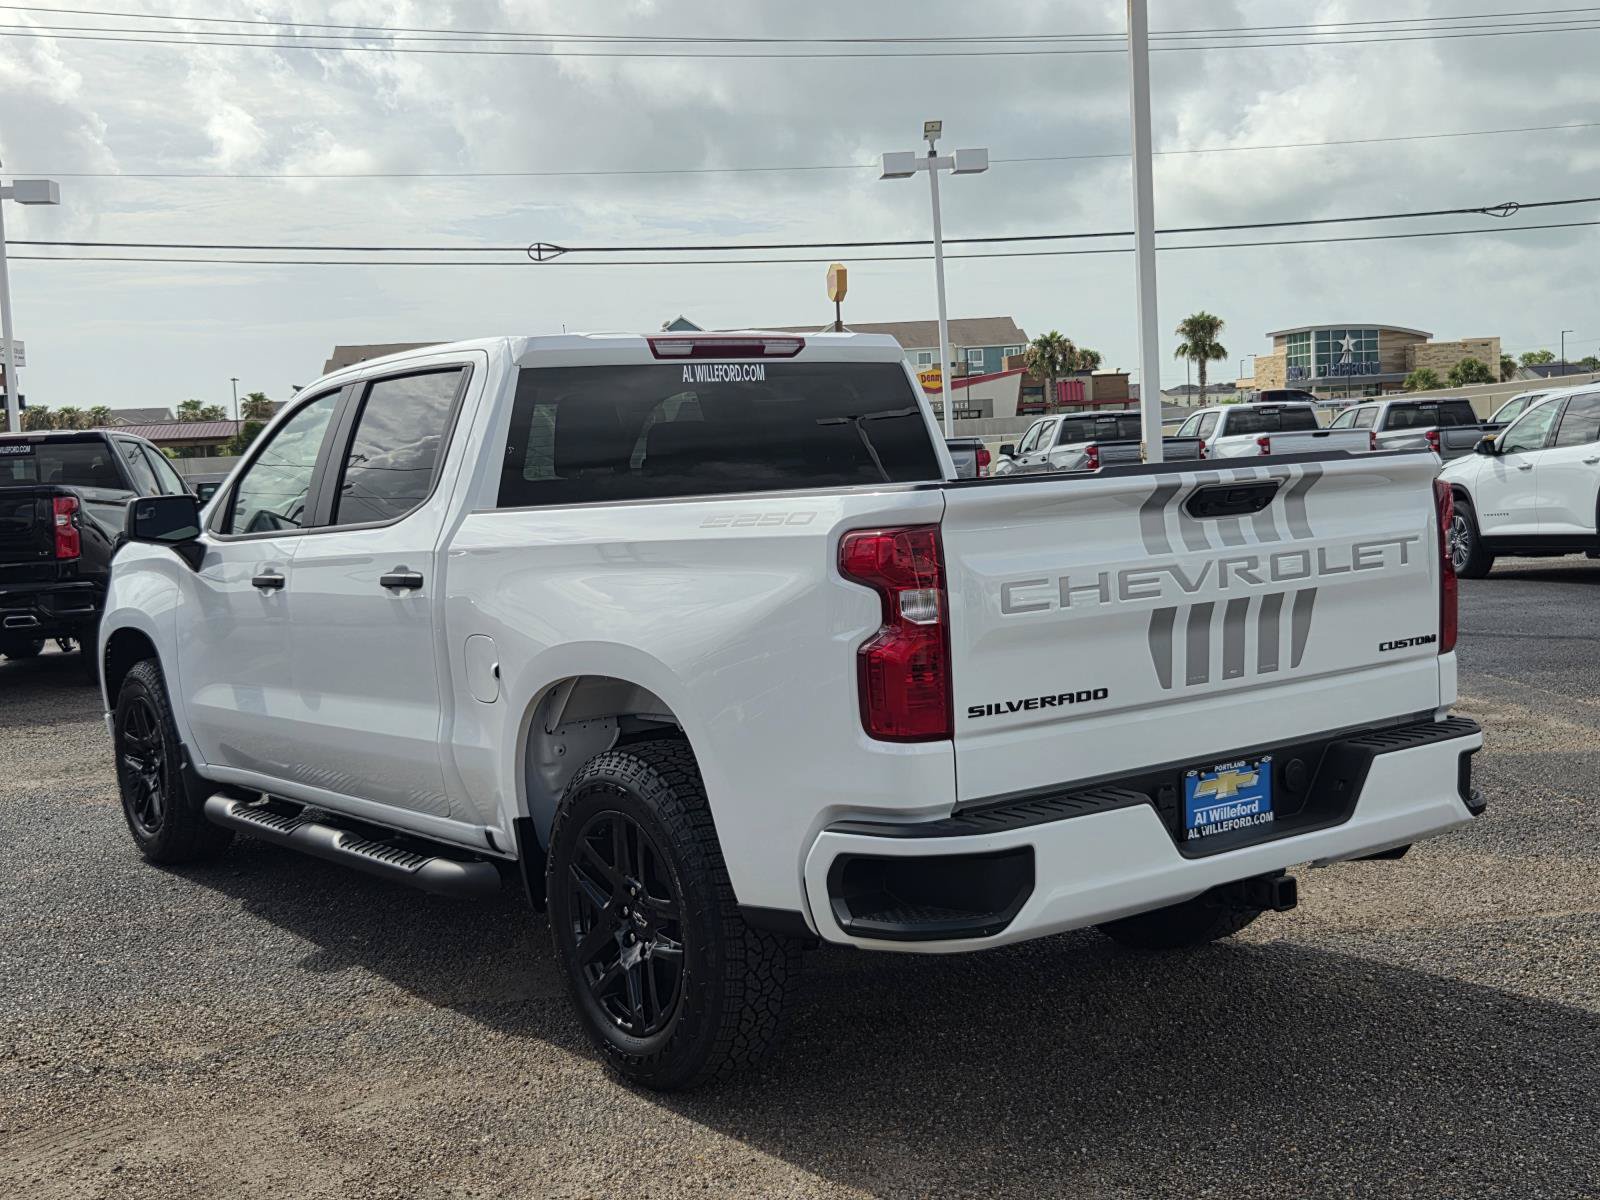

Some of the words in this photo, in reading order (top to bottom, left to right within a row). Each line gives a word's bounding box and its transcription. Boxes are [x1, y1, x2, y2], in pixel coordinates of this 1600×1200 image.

[682, 365, 694, 382] AL
[694, 363, 765, 382] WILLEFORD.COM
[1000, 535, 1420, 616] CHEVROLET
[1378, 633, 1437, 652] CUSTOM
[967, 687, 1109, 719] SILVERADO
[1214, 760, 1246, 772] PORTLAND
[1208, 799, 1259, 821] Willeford
[1187, 828, 1200, 840] AL
[1201, 811, 1274, 836] WILLEFORD.COM
